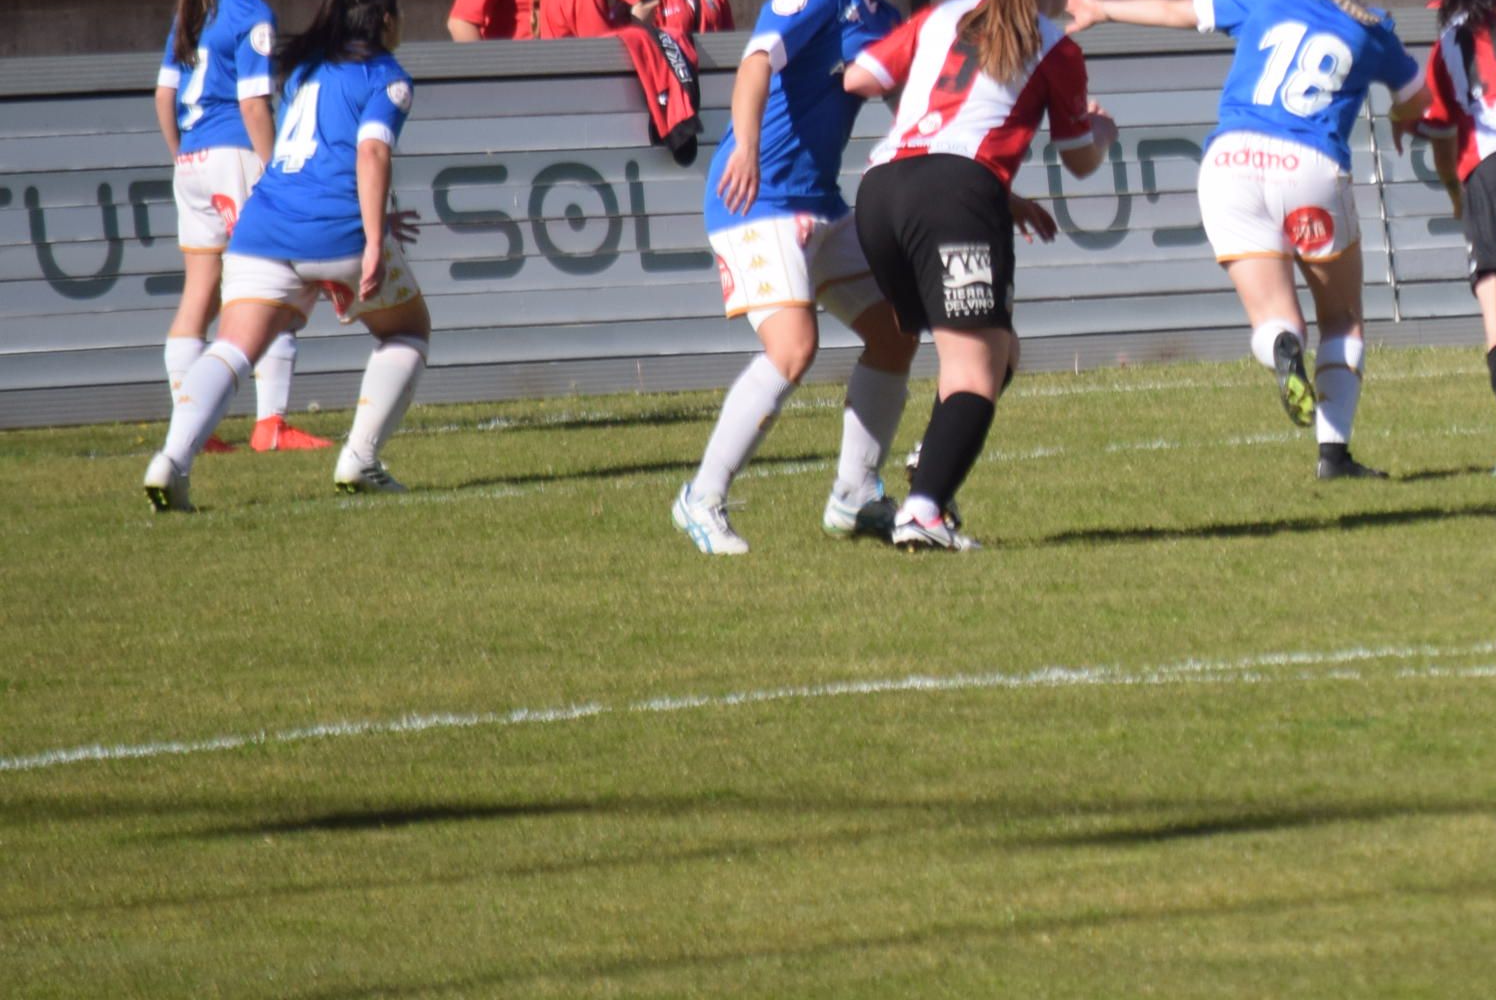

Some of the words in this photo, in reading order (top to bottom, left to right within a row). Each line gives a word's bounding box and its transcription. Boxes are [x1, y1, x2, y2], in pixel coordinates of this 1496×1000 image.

[1251, 21, 1354, 118] 18
[273, 82, 320, 174] 4
[433, 161, 713, 280] SOL
